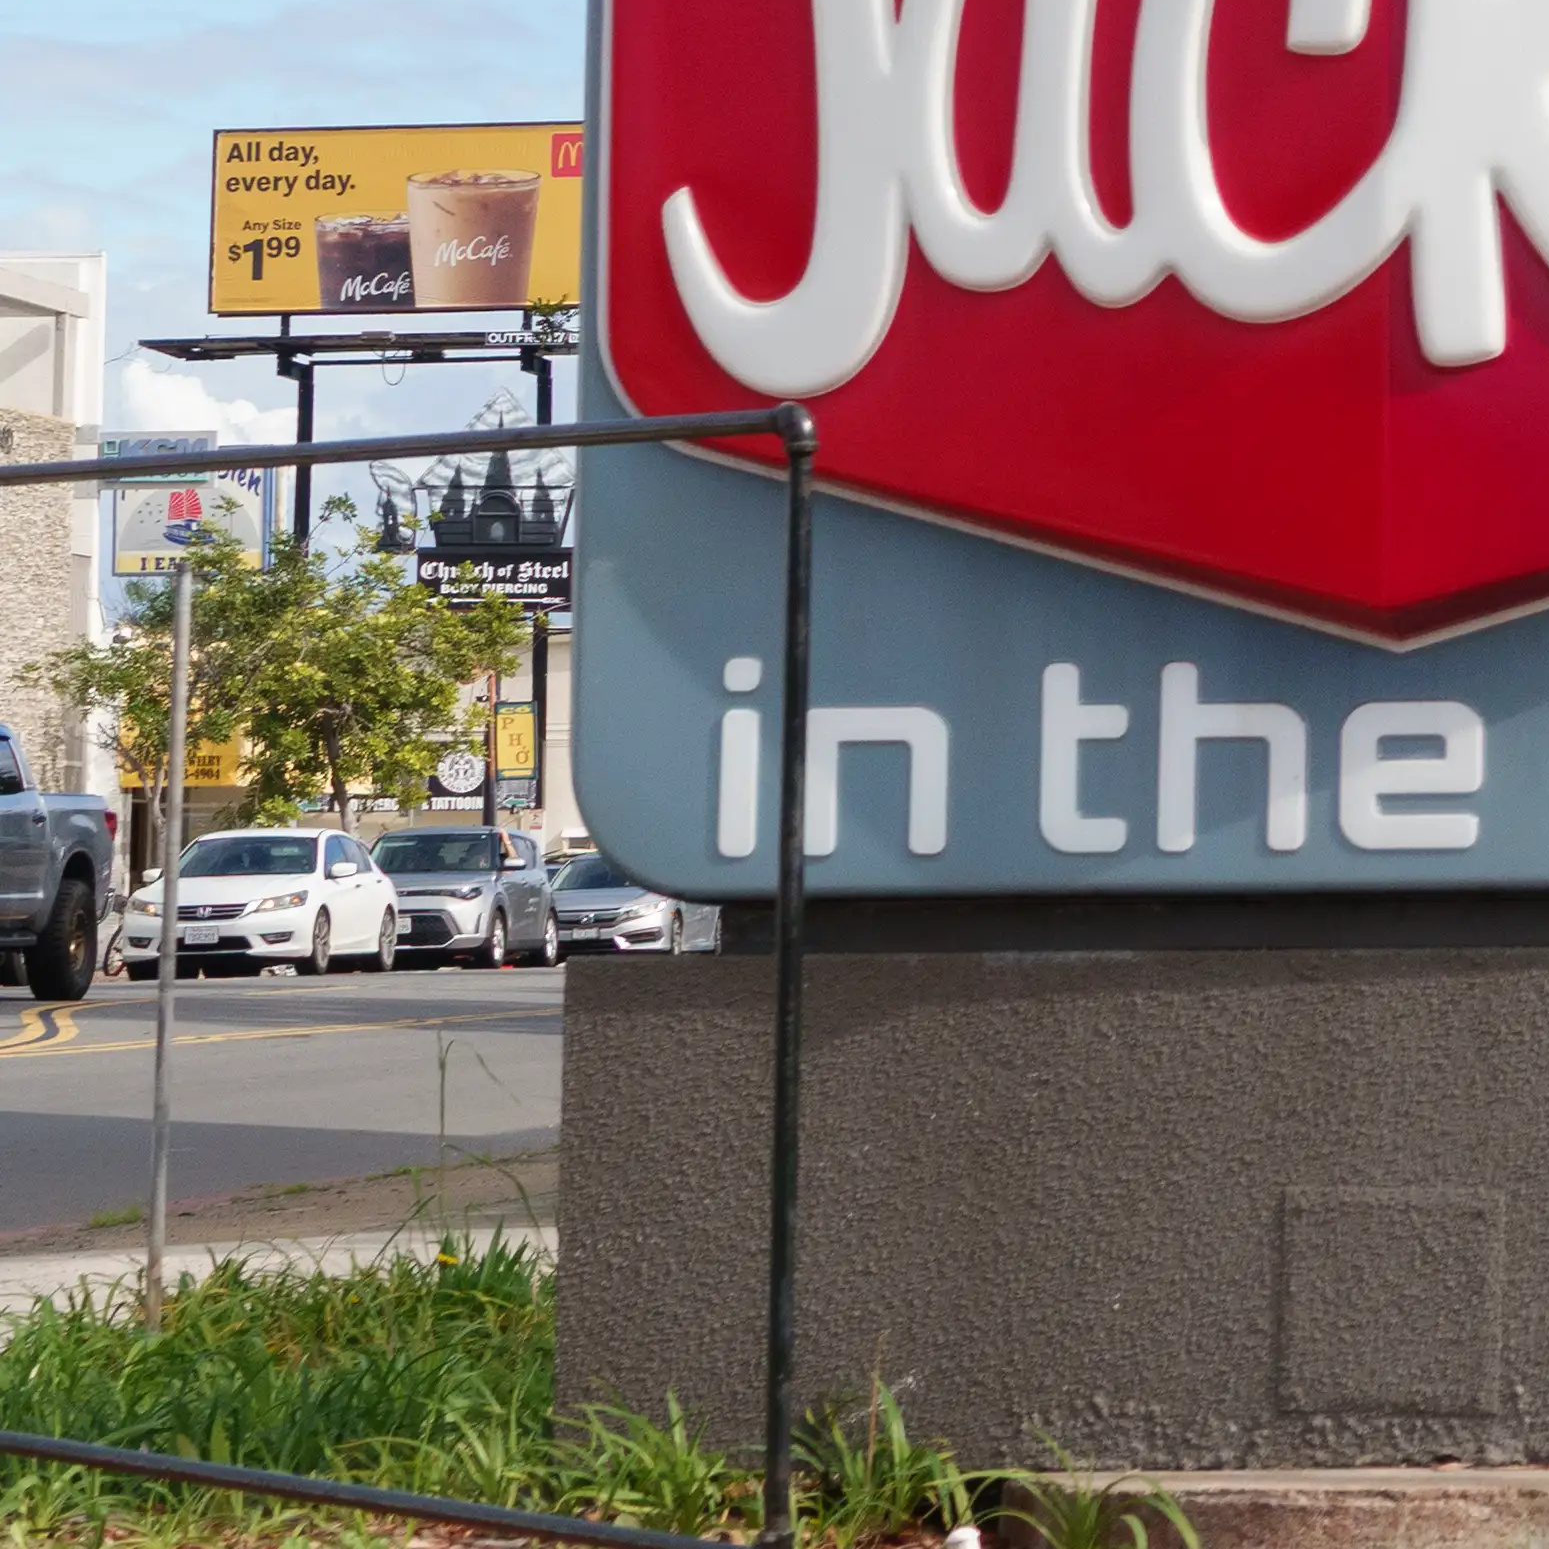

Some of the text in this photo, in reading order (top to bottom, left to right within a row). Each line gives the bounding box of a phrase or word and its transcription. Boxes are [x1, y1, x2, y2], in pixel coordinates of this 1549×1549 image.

[225, 141, 320, 167] All day,
[225, 169, 356, 197] every day.
[242, 219, 302, 234] Any Size
[433, 234, 511, 267] McCafé
[420, 560, 570, 583] Chch of Steel
[482, 583, 548, 594] PIERCING
[716, 656, 950, 860] in
[1038, 660, 1484, 856] the
